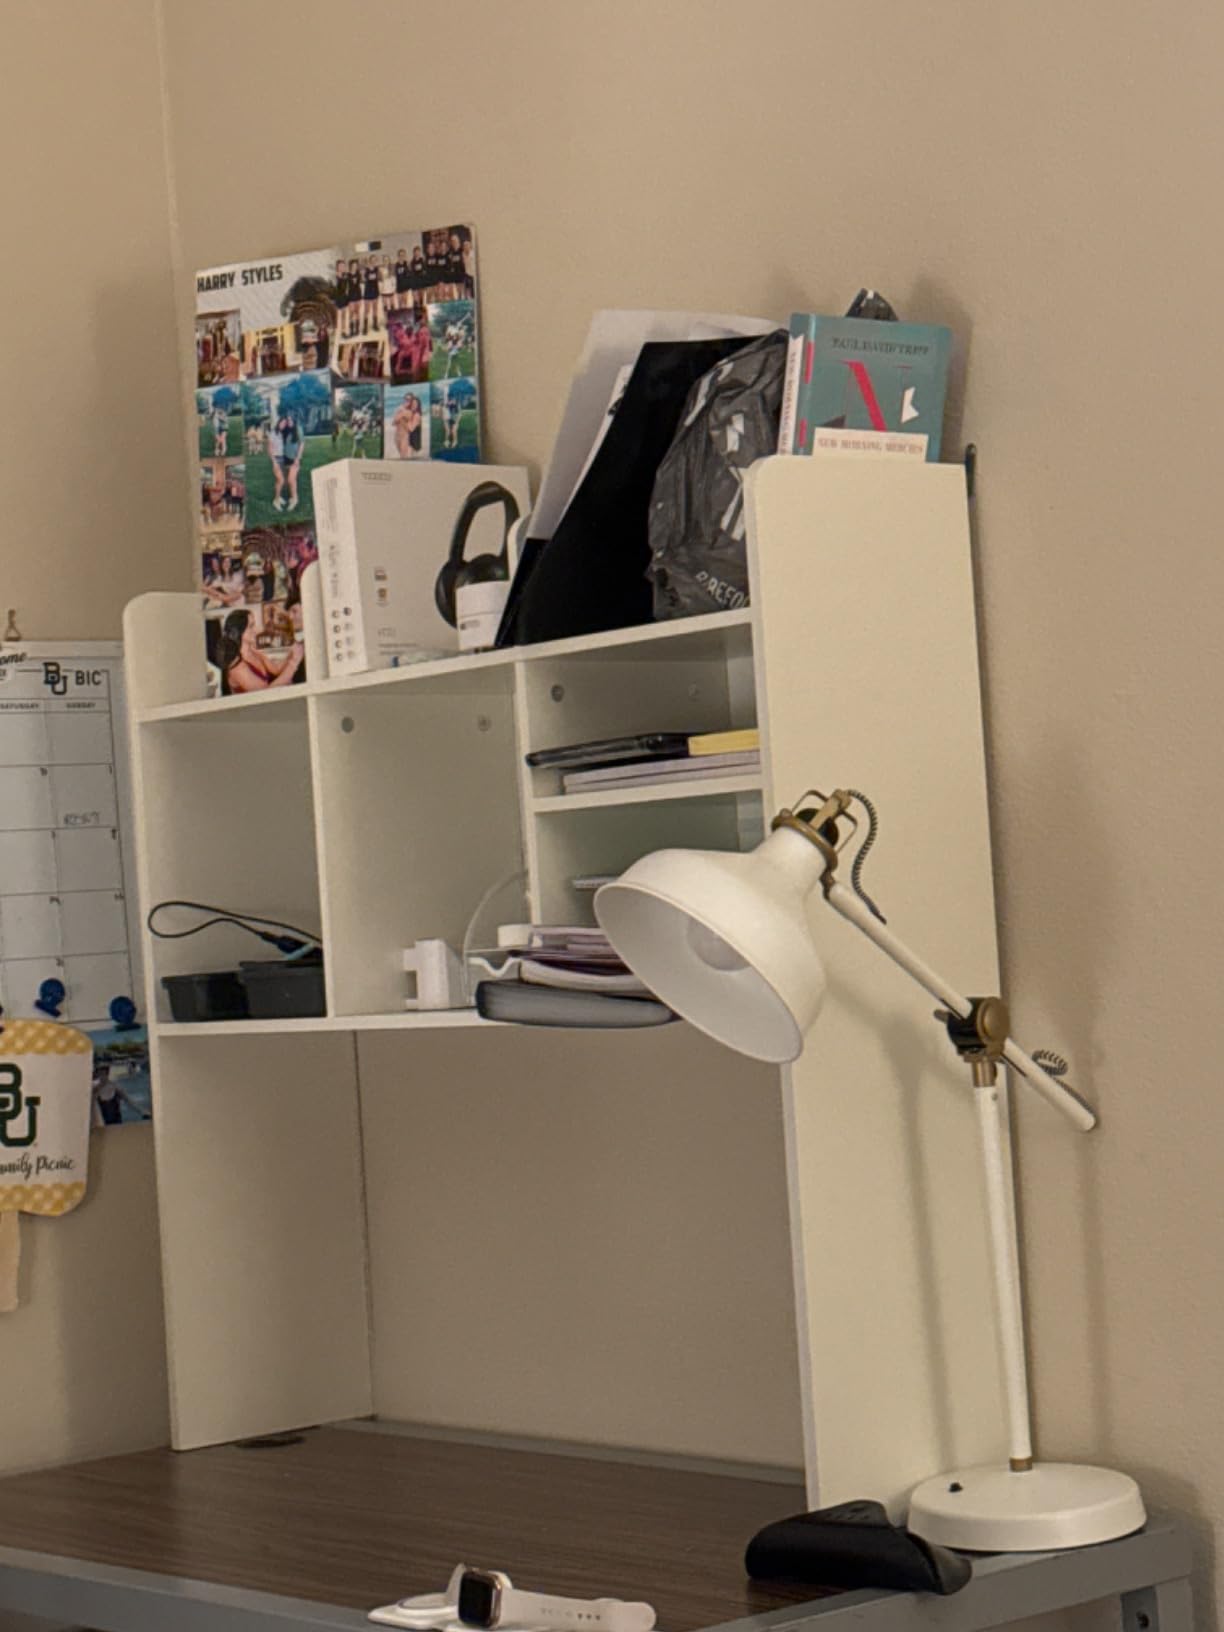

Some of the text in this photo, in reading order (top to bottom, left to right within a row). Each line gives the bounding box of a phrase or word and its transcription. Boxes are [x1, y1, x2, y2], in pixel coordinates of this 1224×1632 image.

[196, 263, 284, 294] HARRY STYLES
[75, 669, 102, 686] BIC
